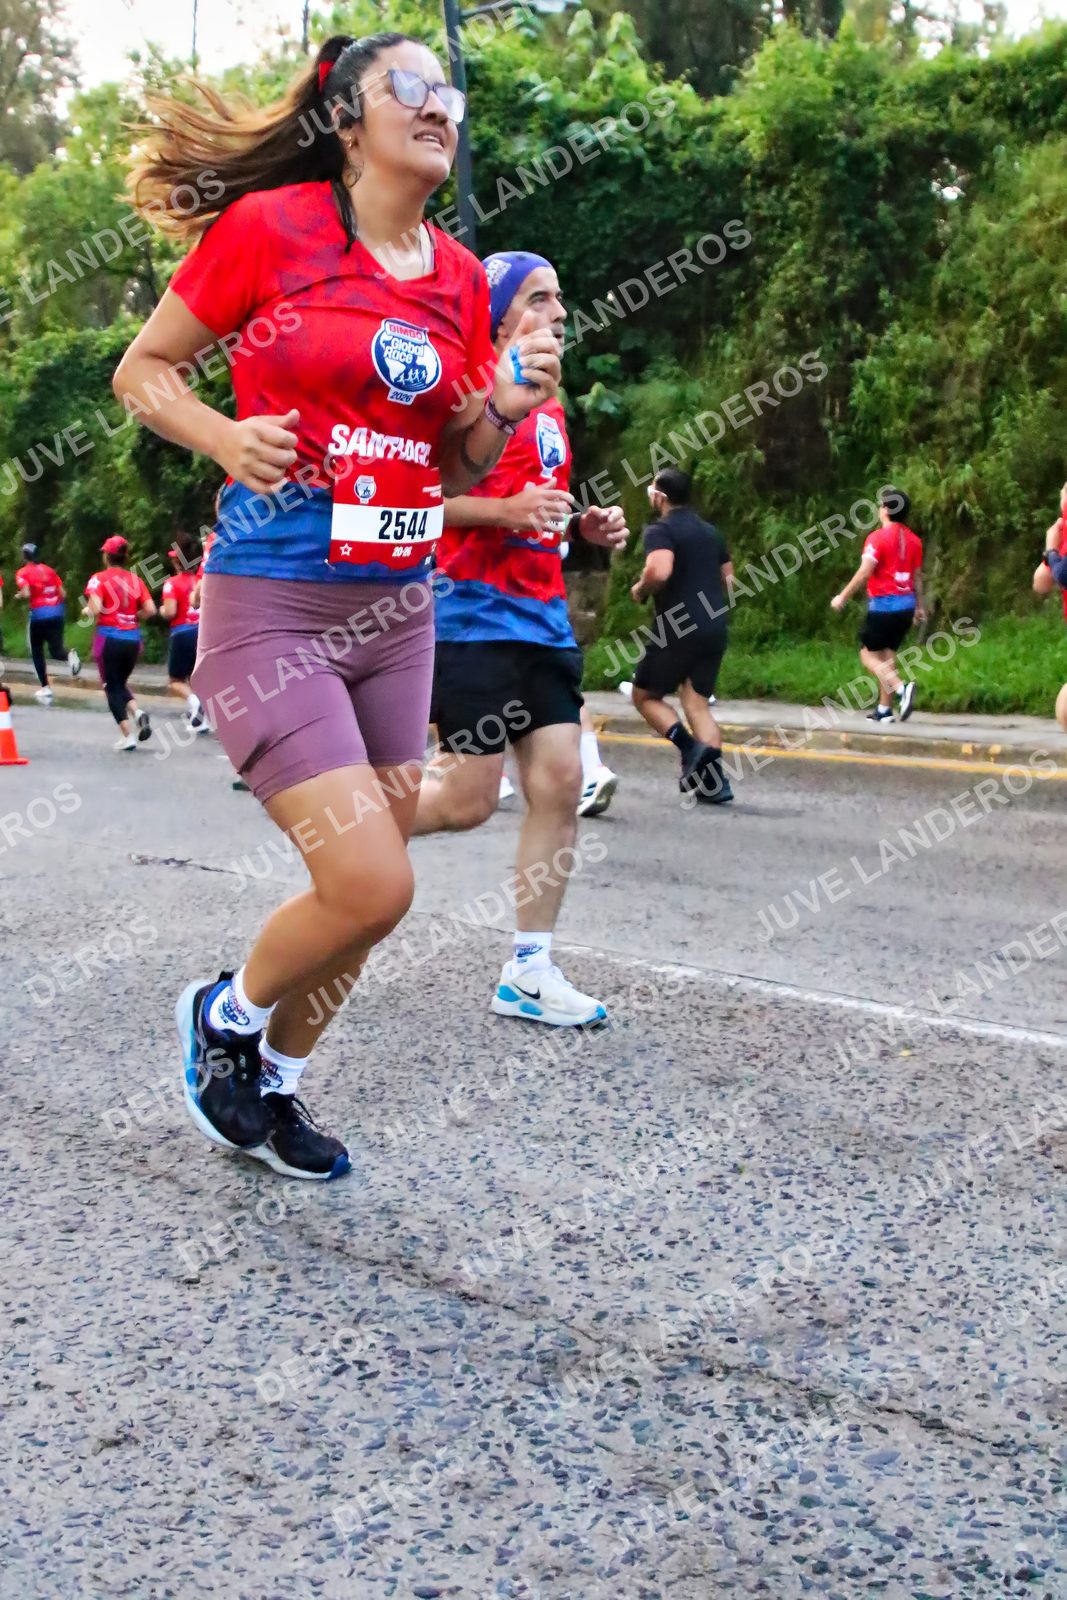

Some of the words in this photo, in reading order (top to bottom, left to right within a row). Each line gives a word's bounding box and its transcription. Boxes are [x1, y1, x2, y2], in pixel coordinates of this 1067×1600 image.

[388, 323, 423, 340] BIMBO
[383, 346, 413, 364] Race
[391, 337, 424, 357] Global
[389, 390, 413, 403] 2026
[378, 509, 429, 540] 2544
